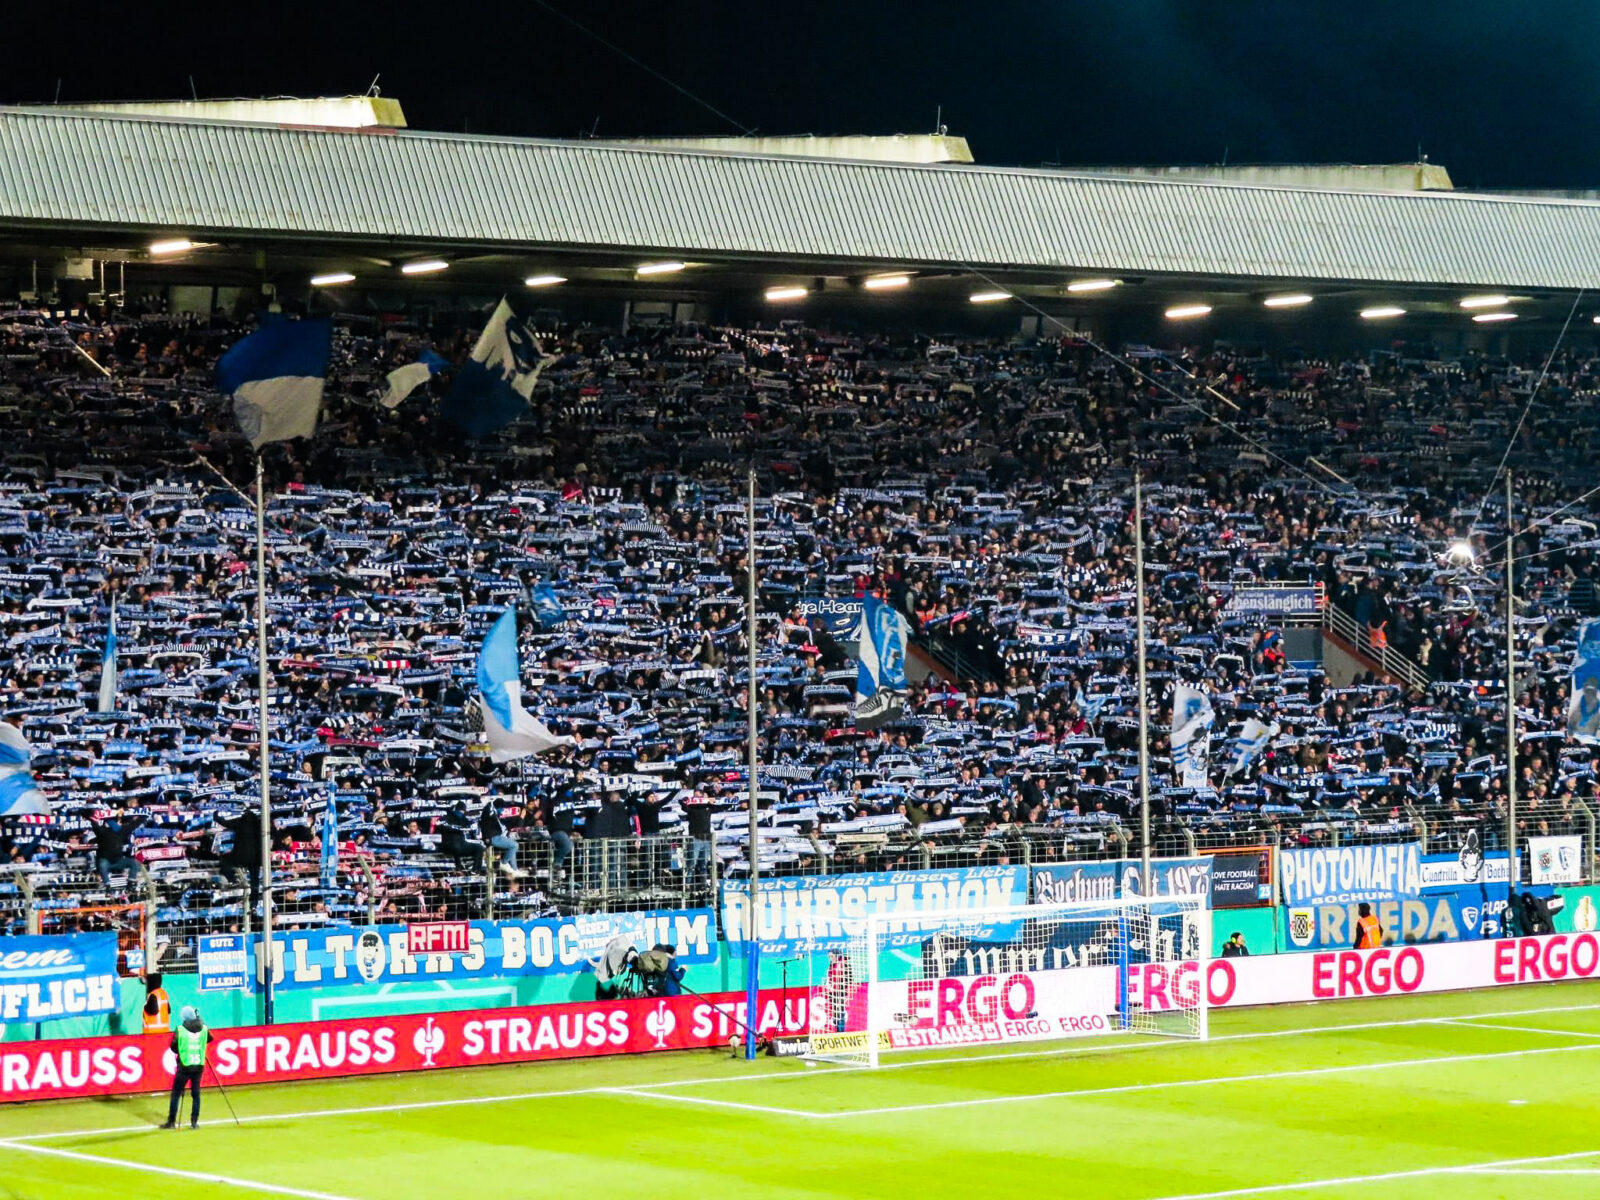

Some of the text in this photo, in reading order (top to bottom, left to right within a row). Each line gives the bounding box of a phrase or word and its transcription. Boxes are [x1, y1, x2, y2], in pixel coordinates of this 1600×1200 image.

[819, 600, 864, 614] Hear
[1225, 593, 1313, 613] ebenslänglich
[1035, 867, 1115, 904] Bochum
[1121, 865, 1159, 897] Ot
[1211, 869, 1258, 880] LOVE FOOTBALL
[1214, 881, 1255, 892] HATE RACISM
[1281, 846, 1420, 905] PHOTOMAFIA
[1260, 885, 1271, 899] 23
[1312, 891, 1394, 905] BOCHUM
[722, 877, 1015, 941] RUHRSTADION
[210, 937, 235, 949] GUTE
[410, 924, 466, 951] RFM
[500, 914, 710, 969] BOCUM
[0, 948, 74, 970] em
[128, 952, 143, 966] 22
[1494, 933, 1600, 984] ERGO
[1115, 959, 1236, 1011] ERGO
[1312, 947, 1425, 998] ERGO
[0, 974, 116, 1019] FLICH
[907, 973, 1036, 1028] ERGO
[691, 995, 848, 1040] STAUS
[1004, 1019, 1051, 1039] ERGO
[1061, 1013, 1105, 1034] ERGO
[463, 1009, 630, 1056] STRAUSS
[777, 1038, 811, 1054] bwin
[909, 1022, 983, 1047] STRAUSS
[215, 1027, 396, 1076] STRAUSS
[0, 1045, 143, 1092] RAUSS
